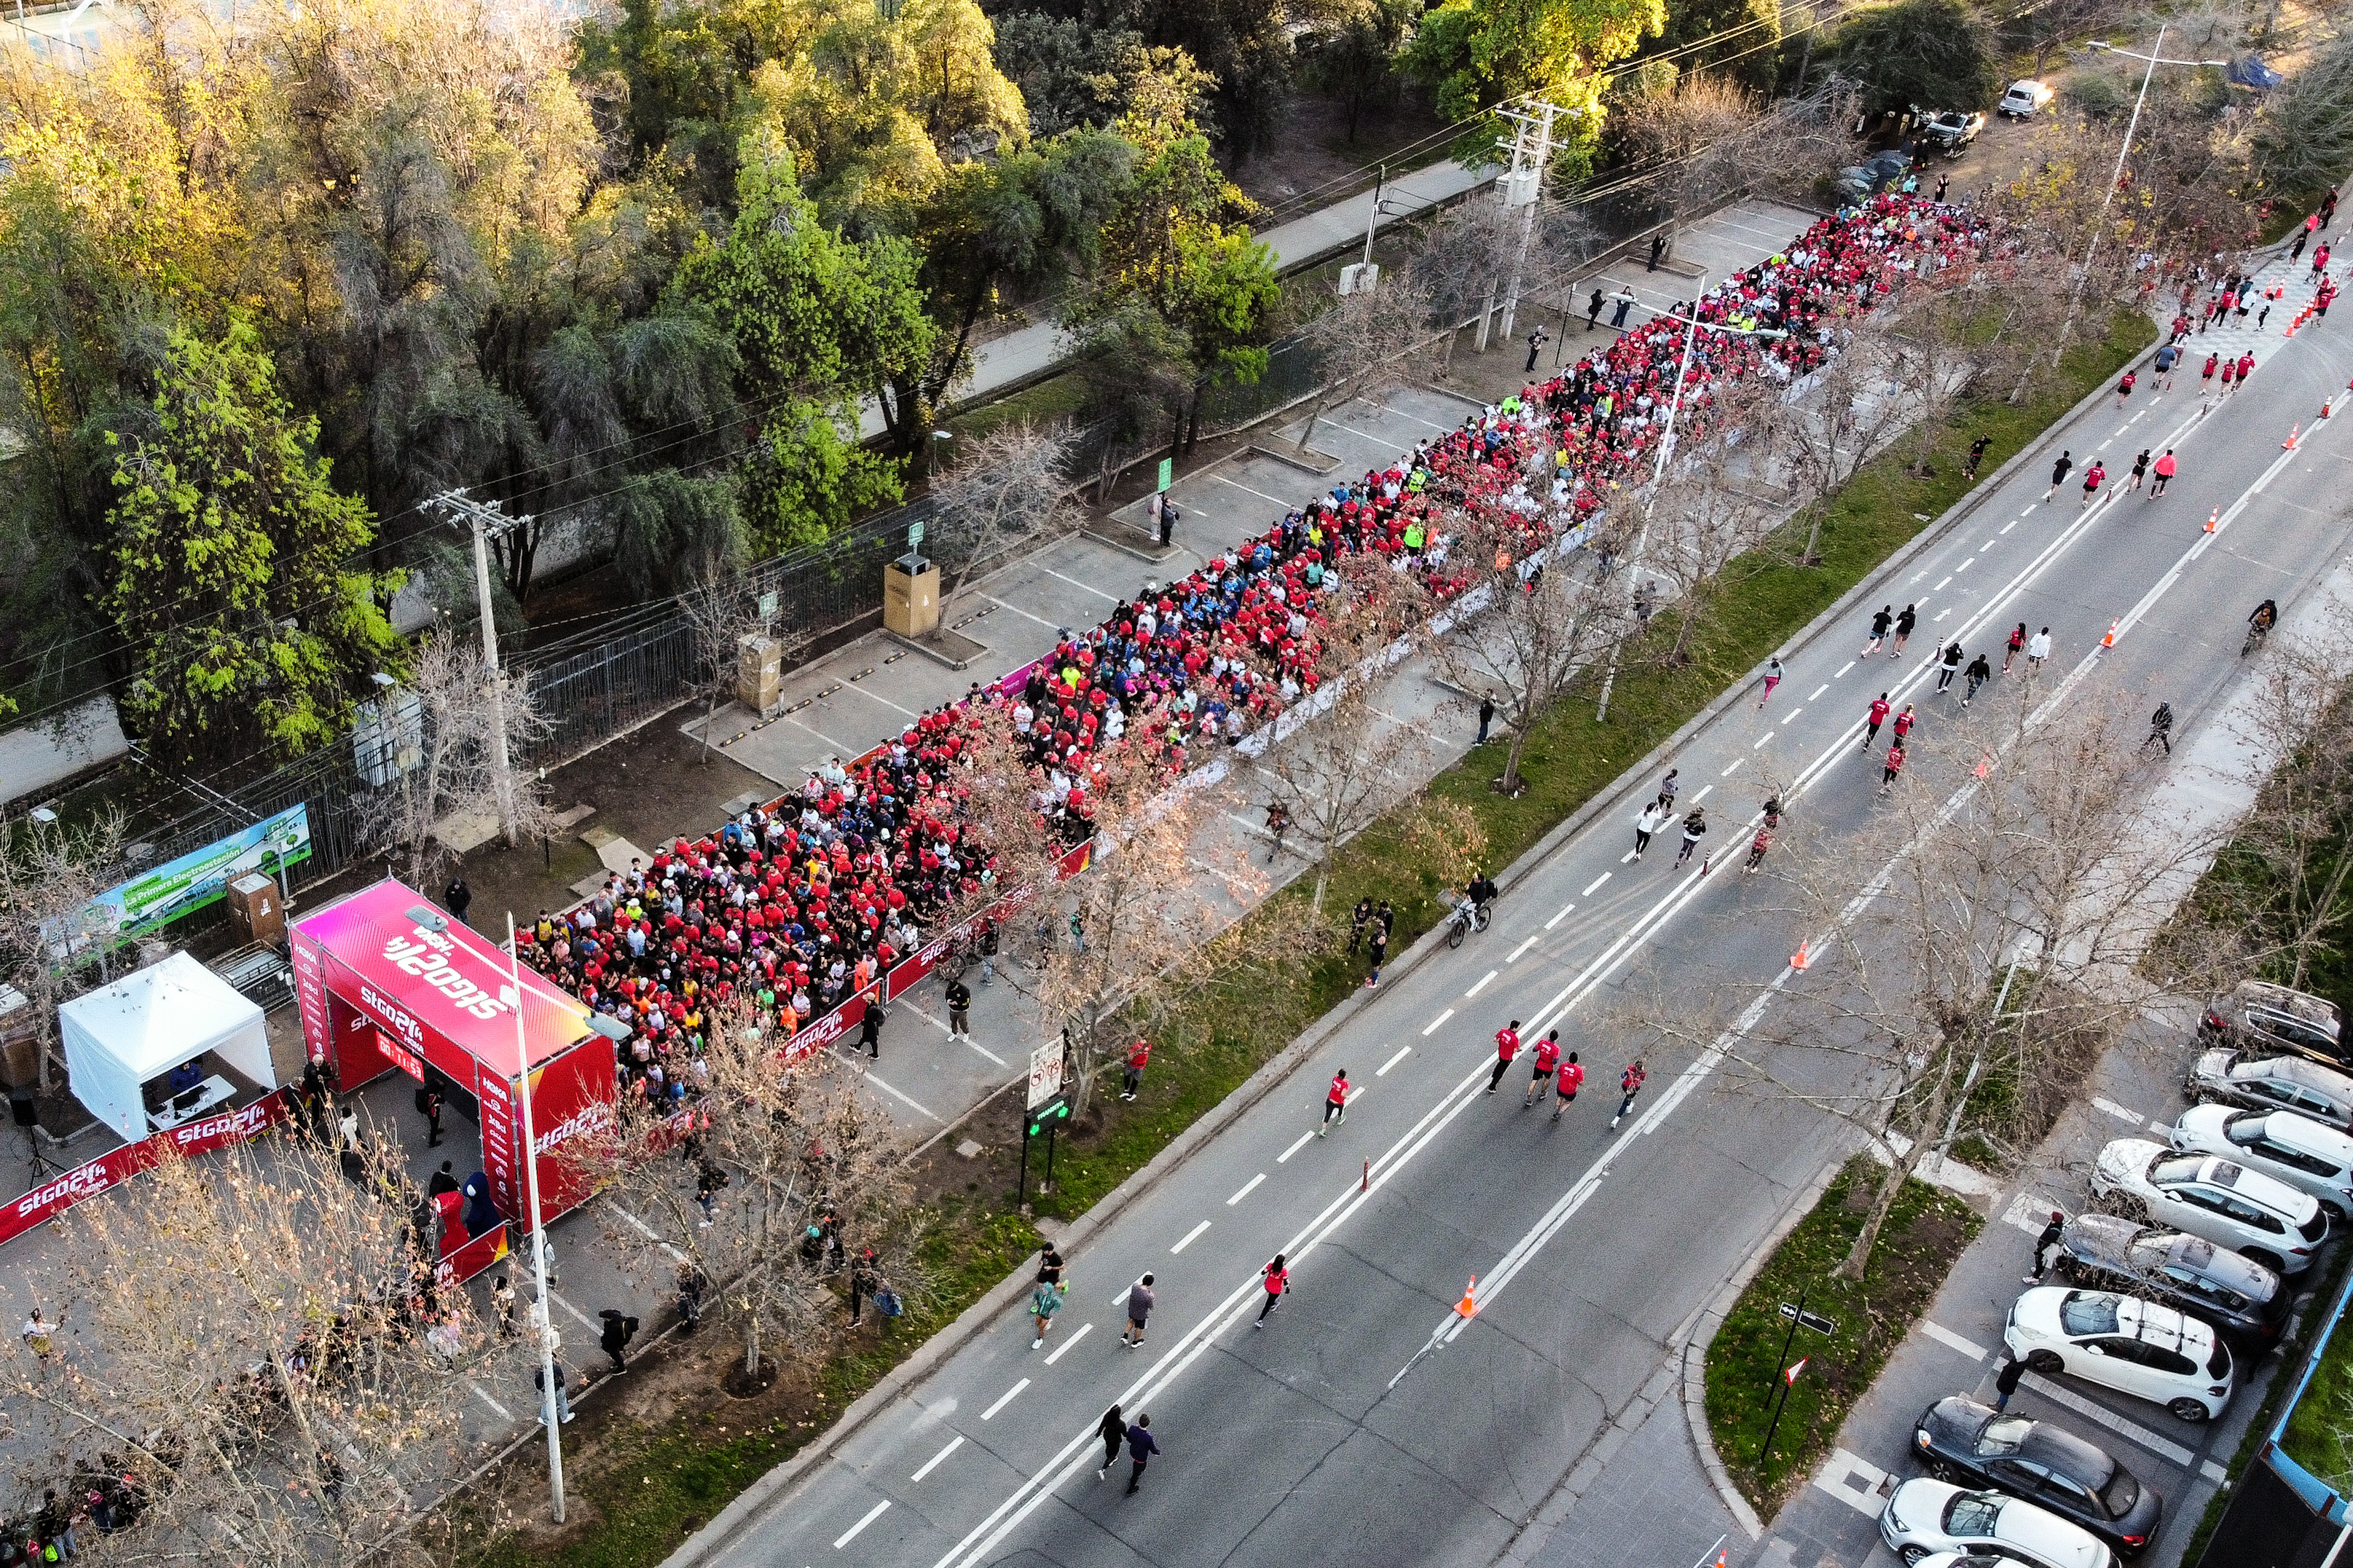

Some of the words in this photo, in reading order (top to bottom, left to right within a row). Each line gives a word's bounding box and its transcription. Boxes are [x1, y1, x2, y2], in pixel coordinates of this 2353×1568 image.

[136, 880, 172, 899] Primera
[295, 943, 317, 965] HOKA
[483, 1077, 508, 1102] HOKA
